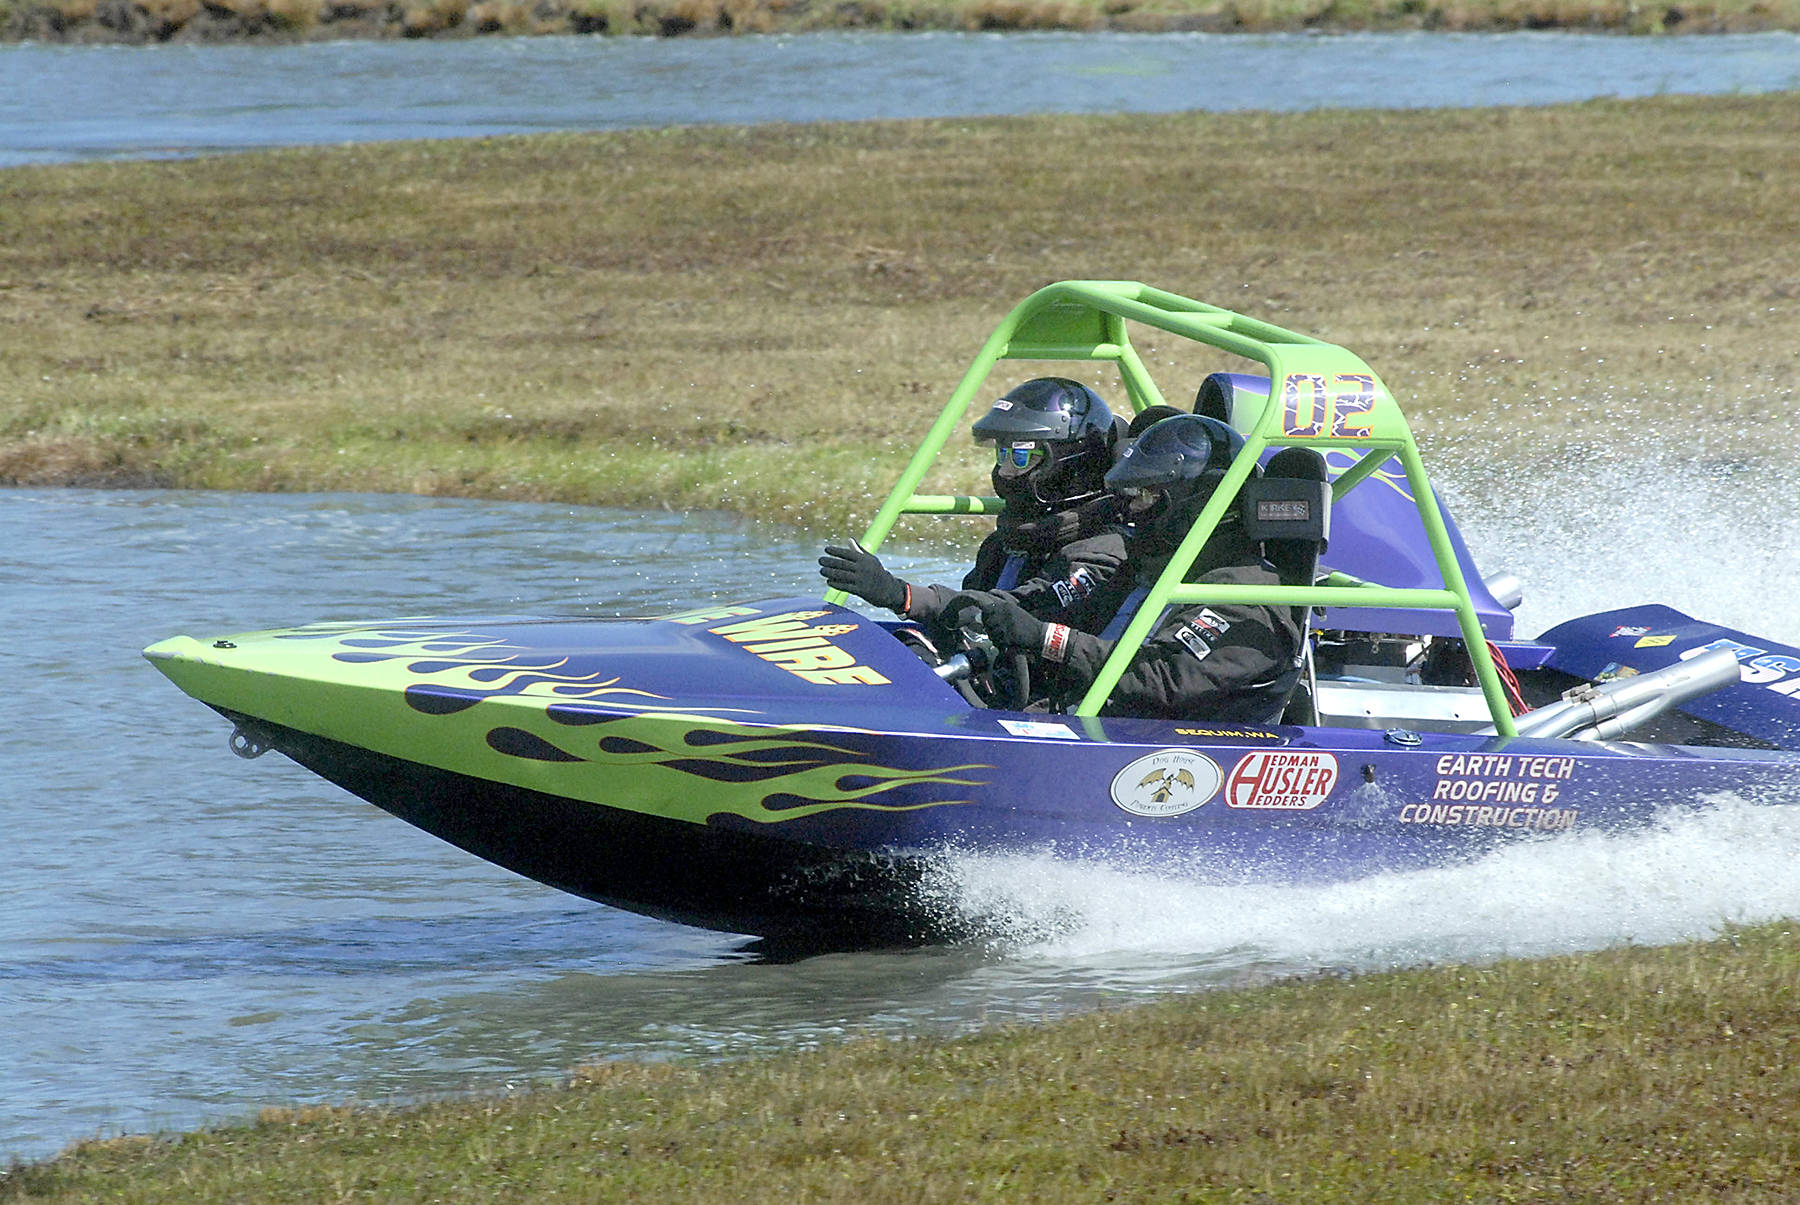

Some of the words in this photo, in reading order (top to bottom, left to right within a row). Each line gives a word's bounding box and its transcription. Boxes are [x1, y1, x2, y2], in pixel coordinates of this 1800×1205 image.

[1282, 373, 1376, 439] 02
[708, 610, 892, 685] WIRE
[1436, 755, 1511, 777] EARTH
[1518, 757, 1576, 779] TECH
[1433, 780, 1539, 803] ROOFING
[1541, 783, 1560, 804] &
[1400, 803, 1579, 830] CONSTRUCTION
